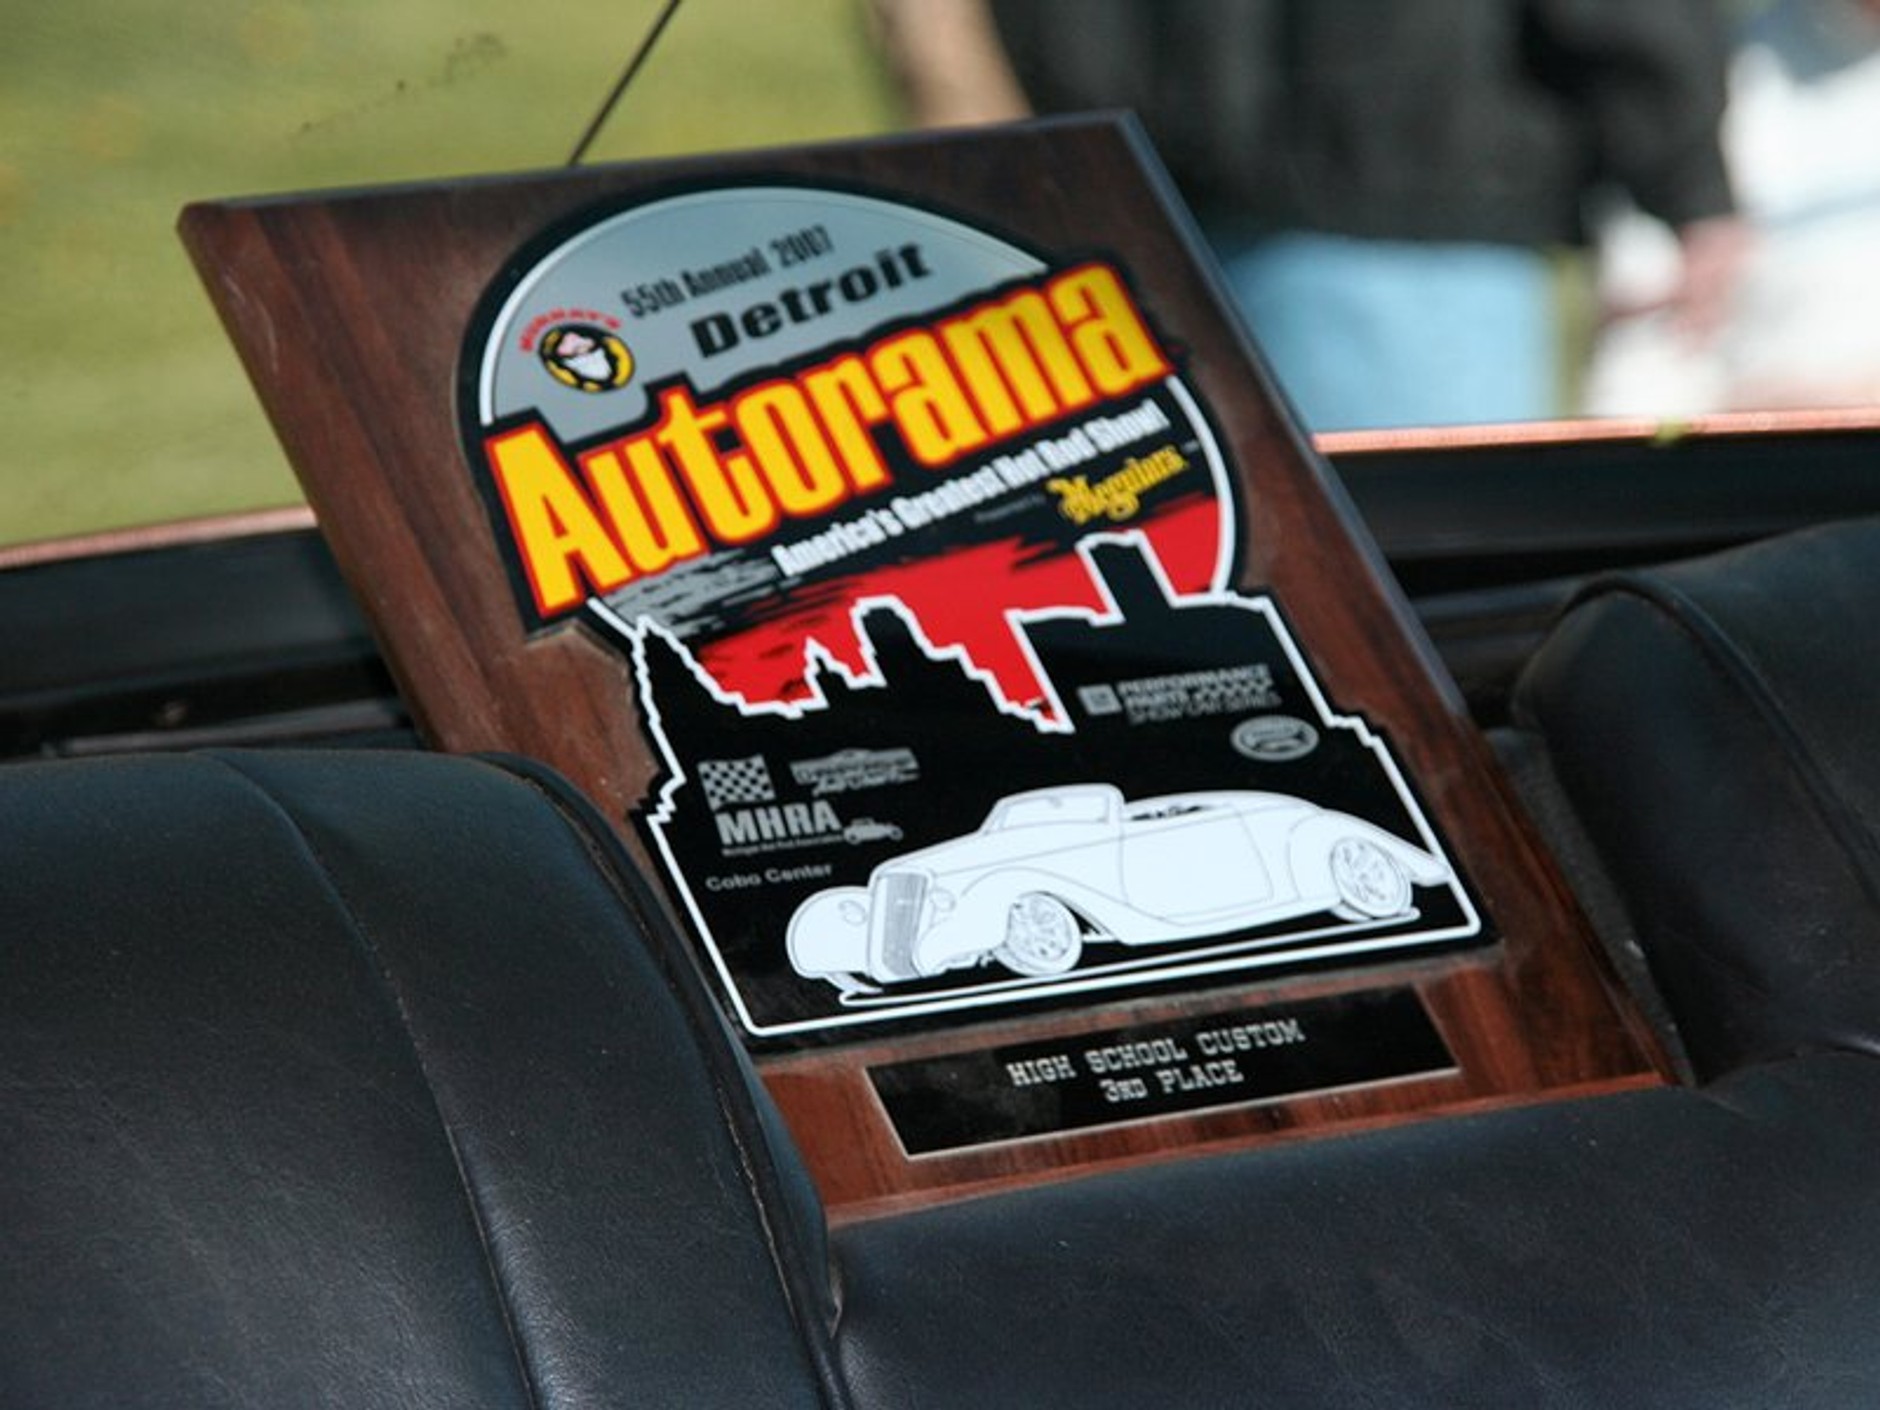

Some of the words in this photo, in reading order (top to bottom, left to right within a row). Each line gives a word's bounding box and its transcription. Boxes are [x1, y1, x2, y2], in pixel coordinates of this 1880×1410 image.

[621, 274, 686, 319] 55th
[683, 247, 772, 297] Annual
[769, 225, 836, 269] 2007
[689, 243, 933, 359] Detroit
[485, 262, 1176, 618] Autorama
[771, 508, 903, 577] America's
[890, 465, 1009, 532] Greatest
[991, 449, 1051, 490] Hot
[1035, 428, 1099, 472] Rod
[714, 800, 843, 846] MHRA
[705, 871, 762, 892] Cobo
[764, 864, 833, 884] Center
[1006, 1055, 1078, 1087] HIGH
[1085, 1038, 1189, 1074] SCHOOL
[1196, 1018, 1307, 1056] CUSTOM
[1156, 1059, 1245, 1094] PLACE
